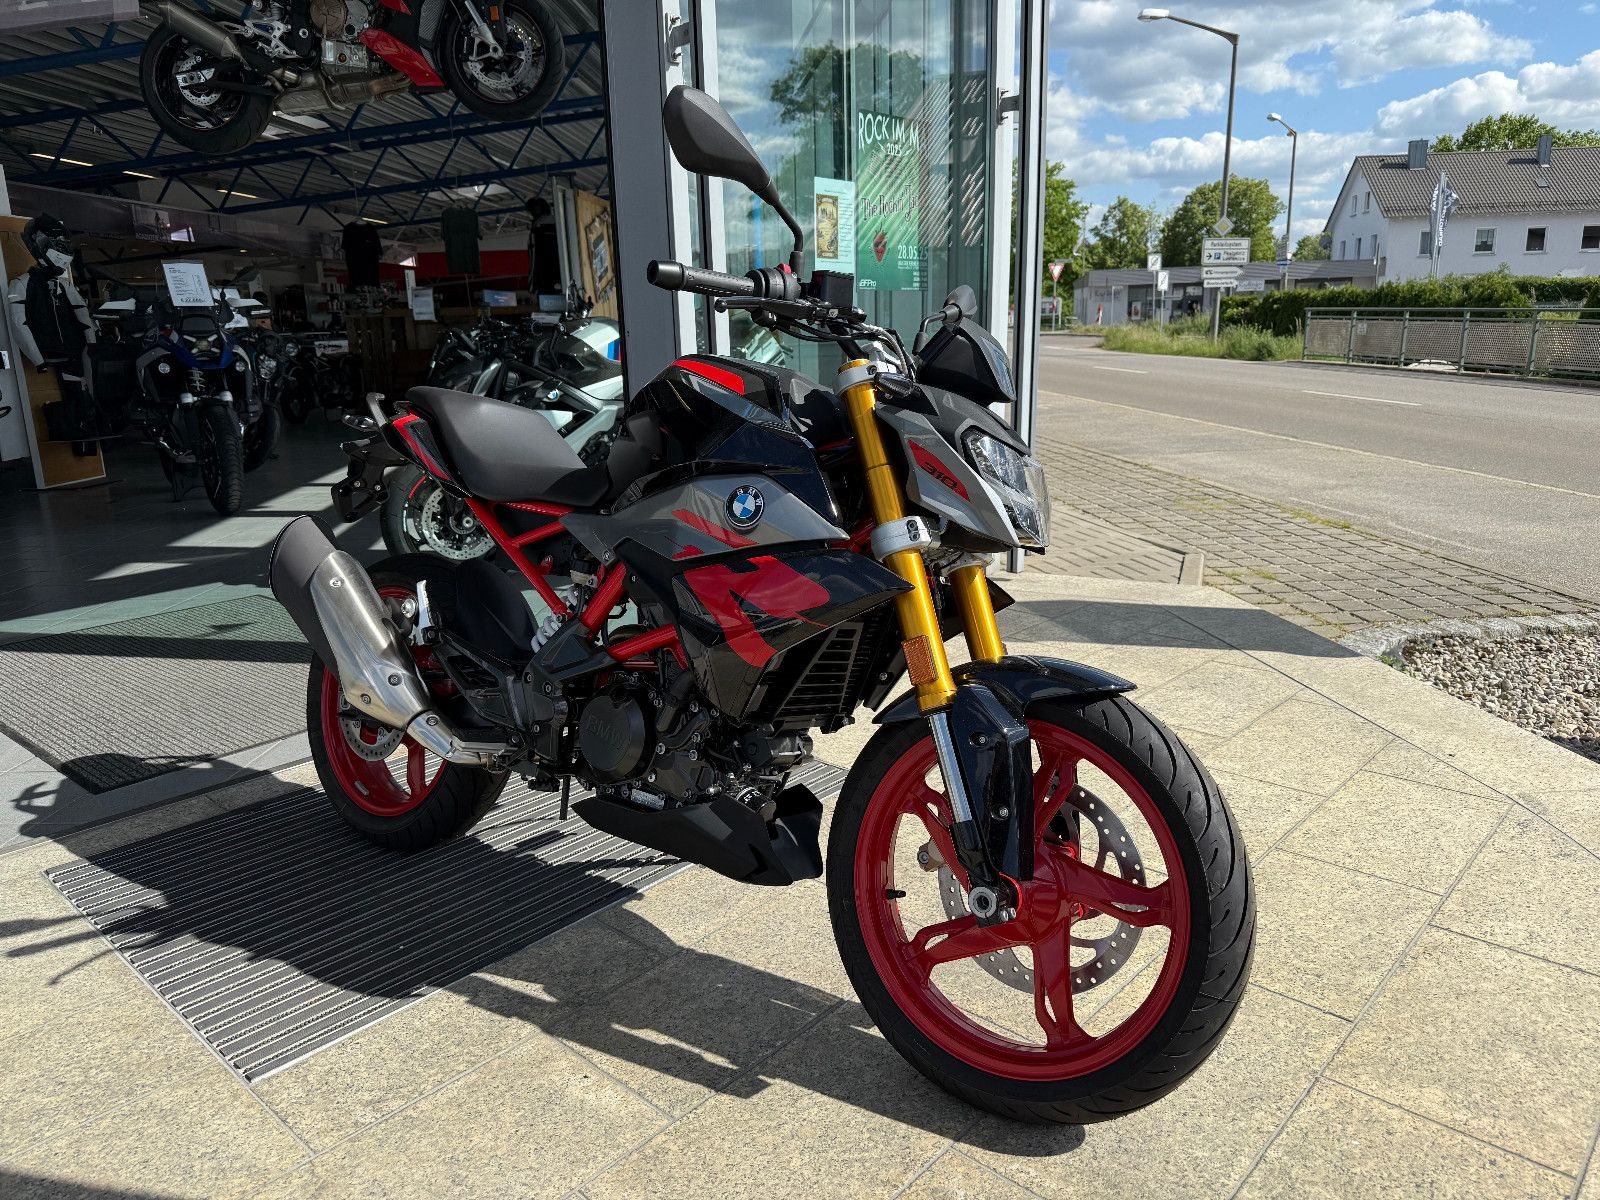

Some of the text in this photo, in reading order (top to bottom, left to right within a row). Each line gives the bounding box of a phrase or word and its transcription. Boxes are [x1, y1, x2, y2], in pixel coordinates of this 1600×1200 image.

[859, 112, 890, 154] ROCK
[892, 118, 906, 144] IM
[886, 143, 902, 157] 2025
[860, 198, 877, 221] The
[898, 245, 928, 260] 28.05.25
[919, 462, 958, 490] 310
[736, 487, 763, 506] BMW
